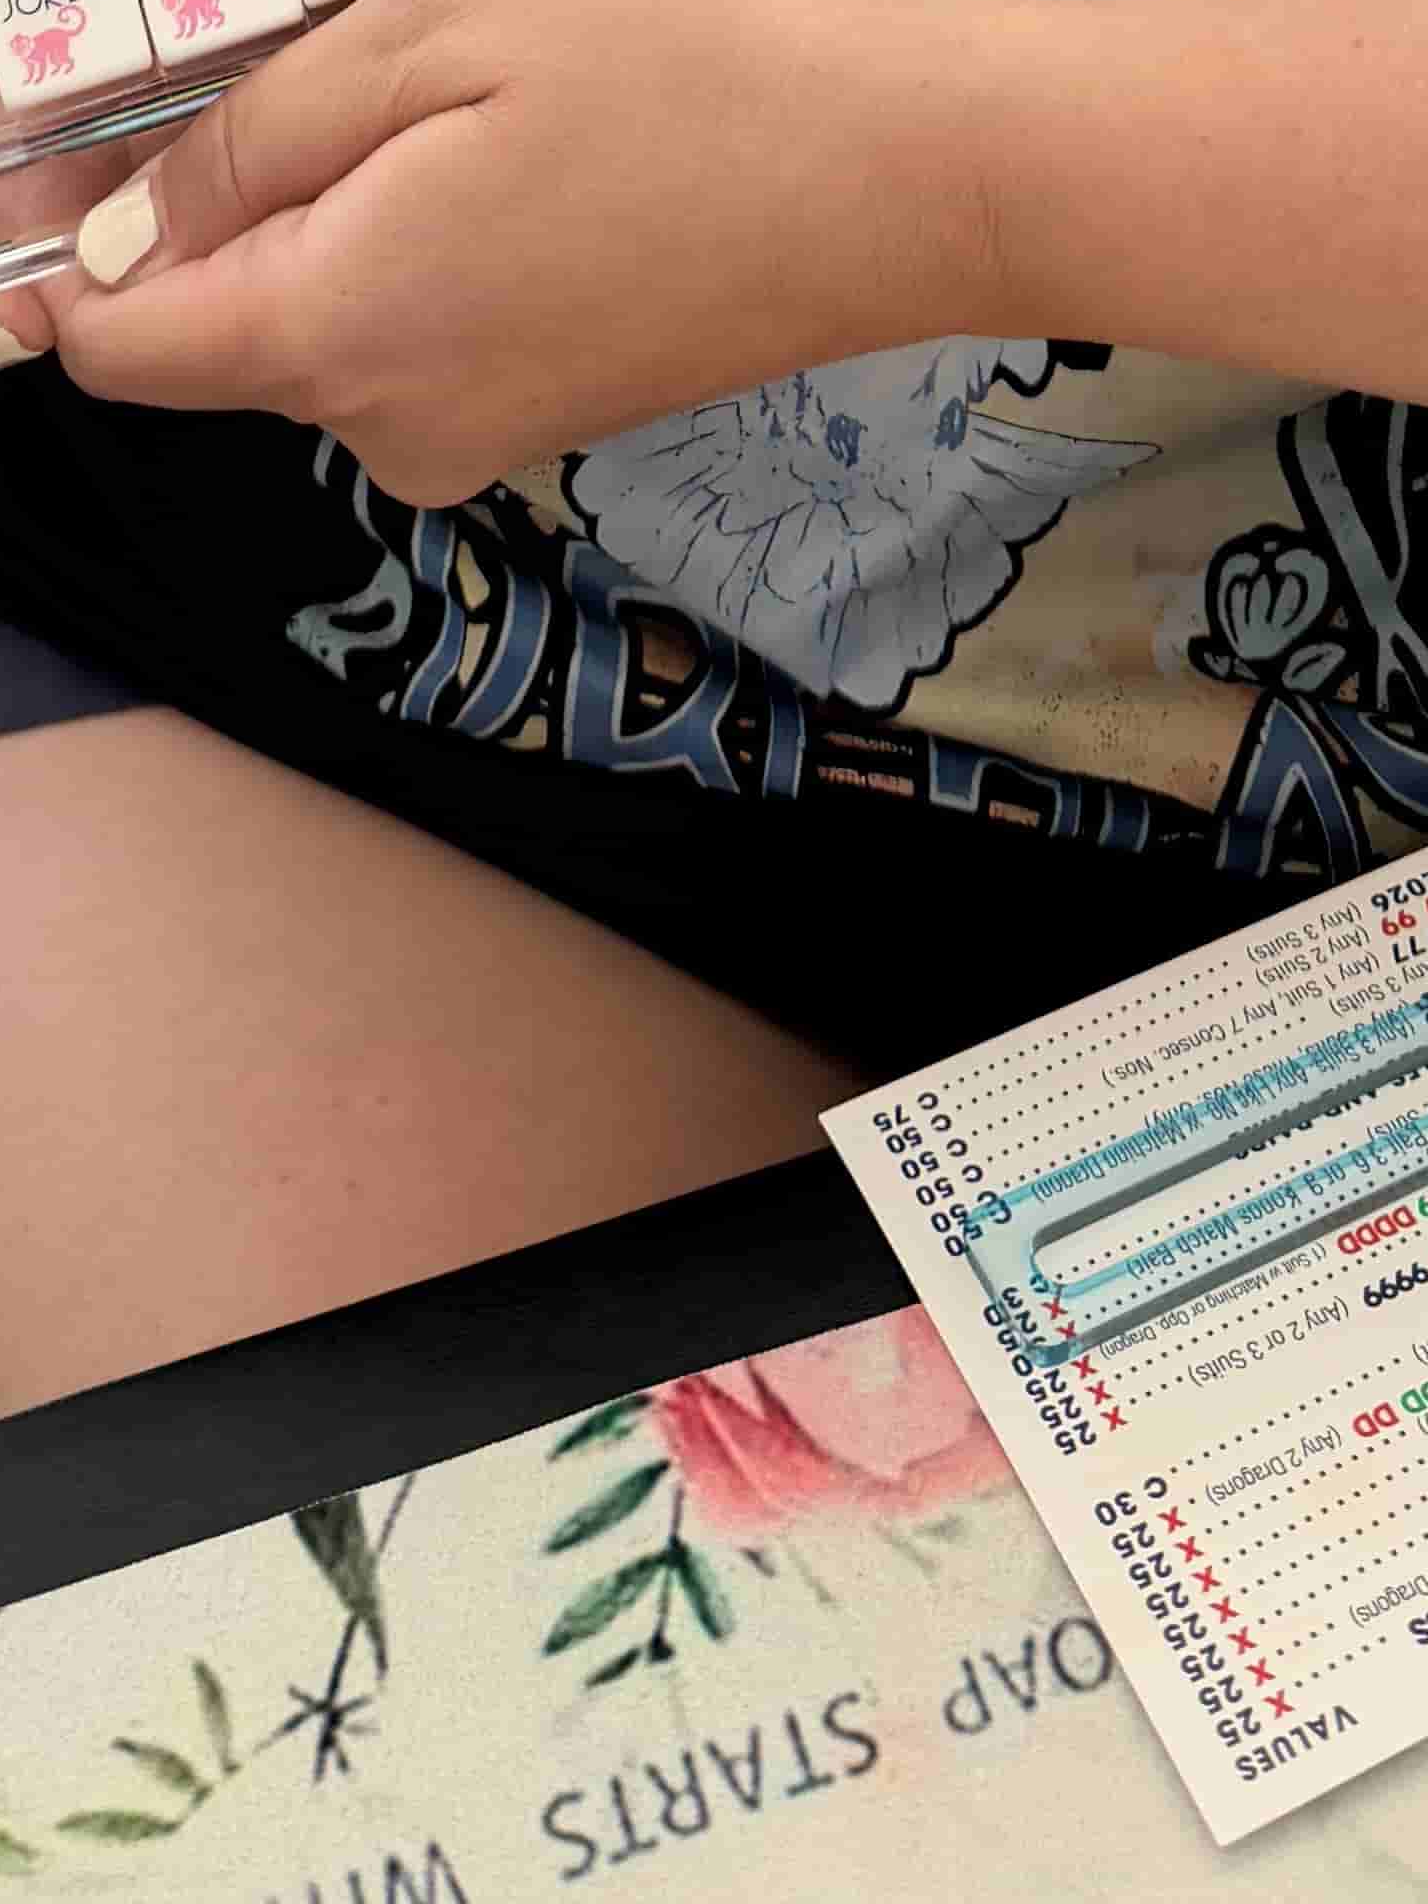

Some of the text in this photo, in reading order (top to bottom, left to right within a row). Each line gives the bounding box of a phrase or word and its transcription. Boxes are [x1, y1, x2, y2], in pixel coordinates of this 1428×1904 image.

[1299, 921, 1314, 942] 3
[1314, 897, 1361, 937] (Any
[1245, 925, 1299, 968] Suits)
[871, 1101, 908, 1135] 75
[916, 1088, 938, 1113] C
[1288, 1318, 1303, 1341] 2
[1300, 1294, 1348, 1336] (Any
[1246, 1337, 1263, 1362] 3
[1263, 1326, 1286, 1351] or
[1187, 1343, 1247, 1391] Suits)
[1038, 1393, 1082, 1432] 25
[1085, 1378, 1111, 1408] X
[1101, 1404, 1126, 1433] X
[1349, 1398, 1398, 1442] DD
[1053, 1419, 1096, 1458] 25
[1285, 1446, 1300, 1468] 2
[1297, 1423, 1342, 1463] (Any
[1142, 1472, 1169, 1503] C
[1204, 1451, 1285, 1510] Dragons)
[1093, 1487, 1137, 1529] 30
[1159, 1504, 1185, 1536] X
[1110, 1519, 1156, 1561] 25
[1192, 1563, 1219, 1596] X
[1144, 1579, 1190, 1622] 25
[1246, 1656, 1274, 1689] X
[1195, 1672, 1243, 1717] 25
[1262, 1686, 1293, 1722] X
[1214, 1704, 1262, 1750] 25
[1233, 1700, 1357, 1785] VALUES
[541, 1690, 882, 1881] STARTS
